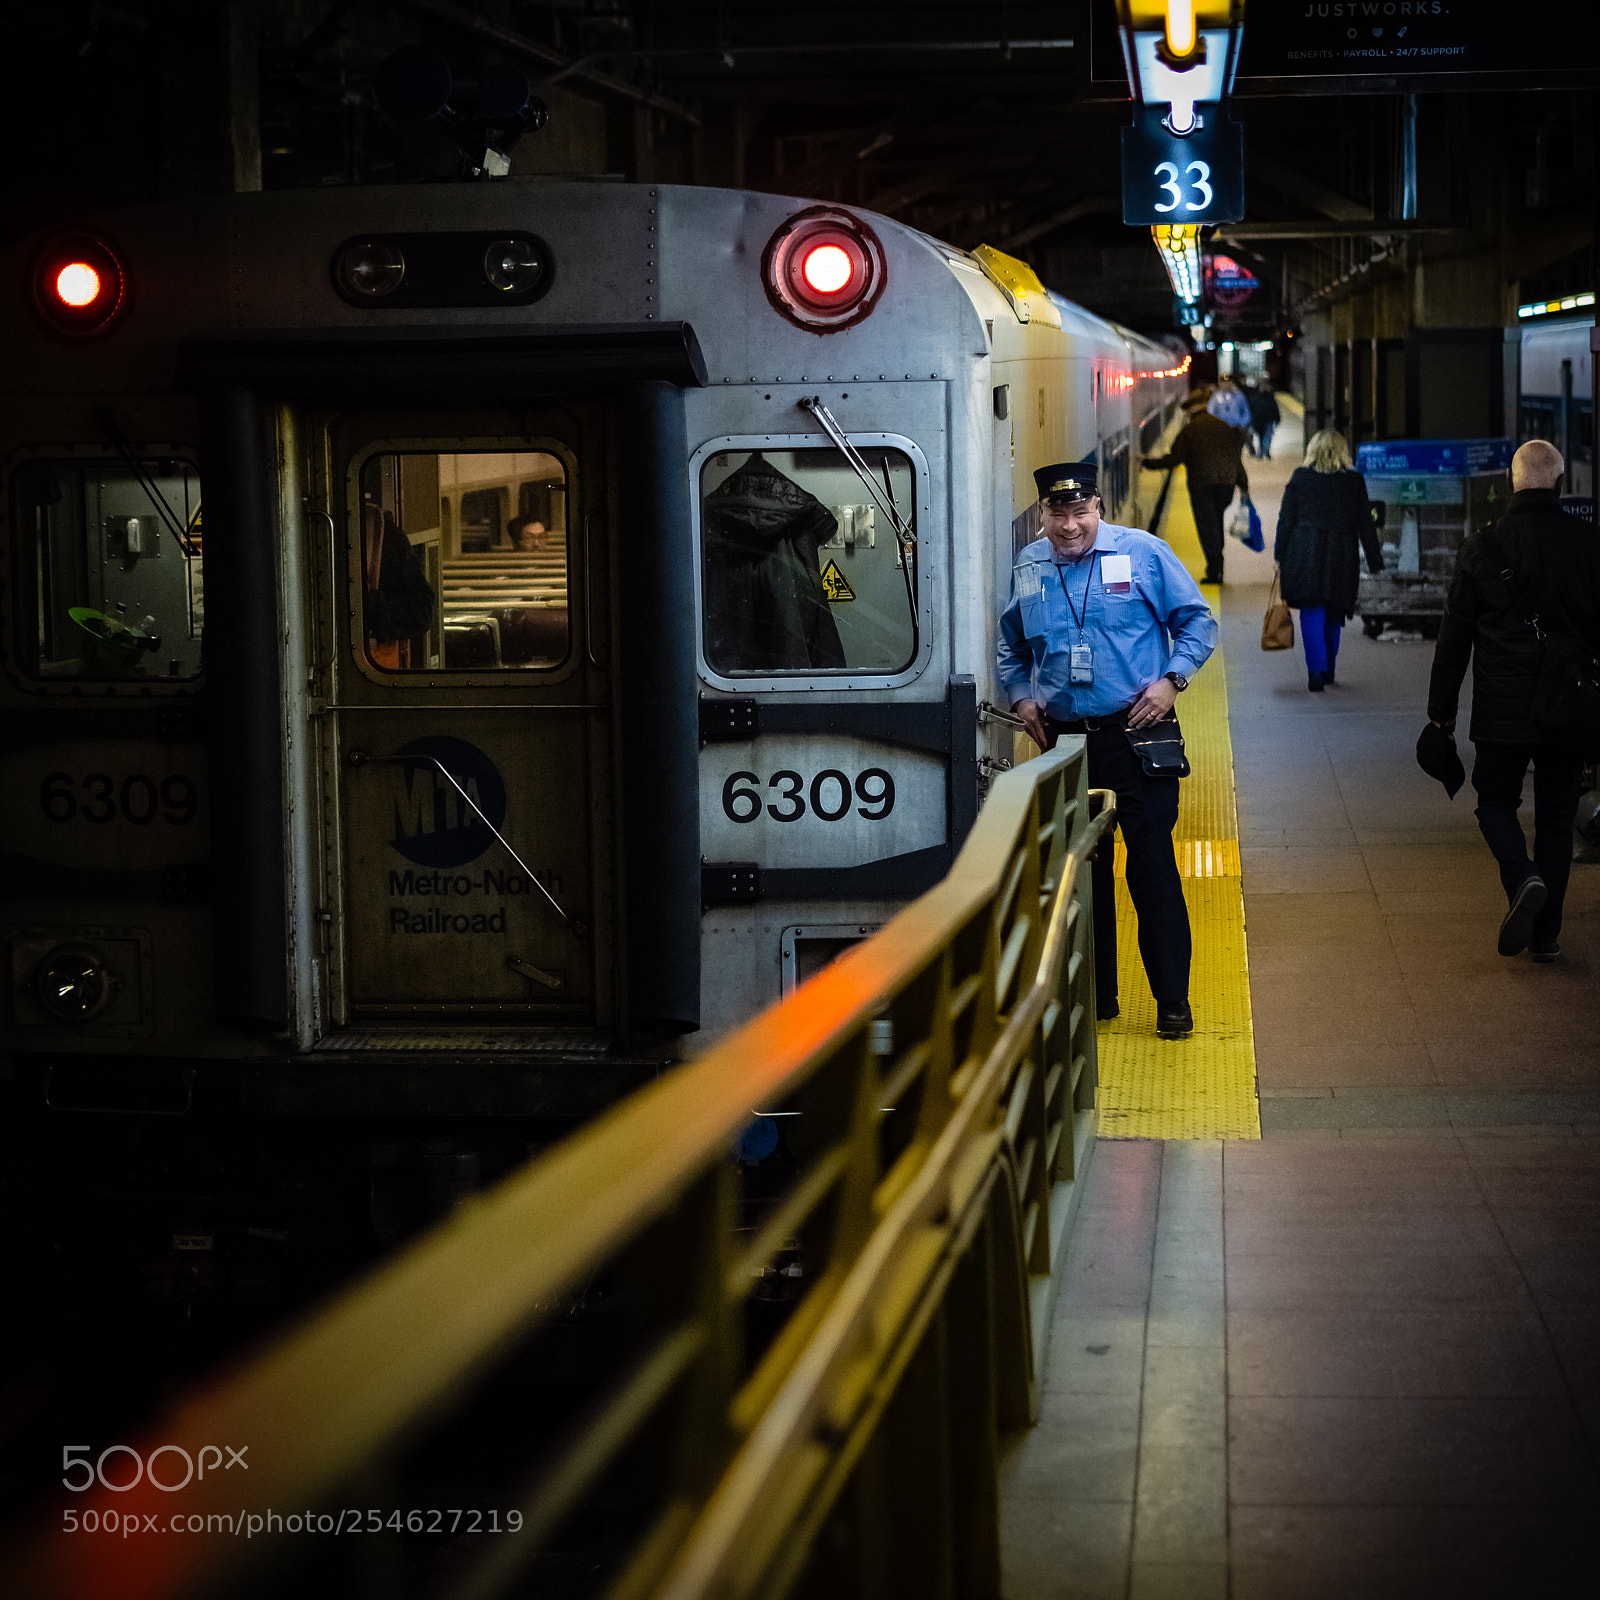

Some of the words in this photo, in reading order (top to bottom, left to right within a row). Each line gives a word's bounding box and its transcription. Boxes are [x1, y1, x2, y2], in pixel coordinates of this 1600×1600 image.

[1304, 1, 1451, 18] JUSTWORKS.
[1287, 49, 1334, 60] BENEFITS
[1342, 48, 1388, 59] PAYROLL
[1395, 47, 1419, 58] 24/7
[1420, 45, 1467, 57] SUPPORT
[1153, 160, 1214, 214] 33
[1562, 504, 1593, 515] SHO
[41, 773, 197, 825] 6309
[389, 764, 484, 840] MTA
[722, 767, 896, 824] 6309
[389, 869, 564, 896] Metro-North
[390, 907, 506, 934] Railroad
